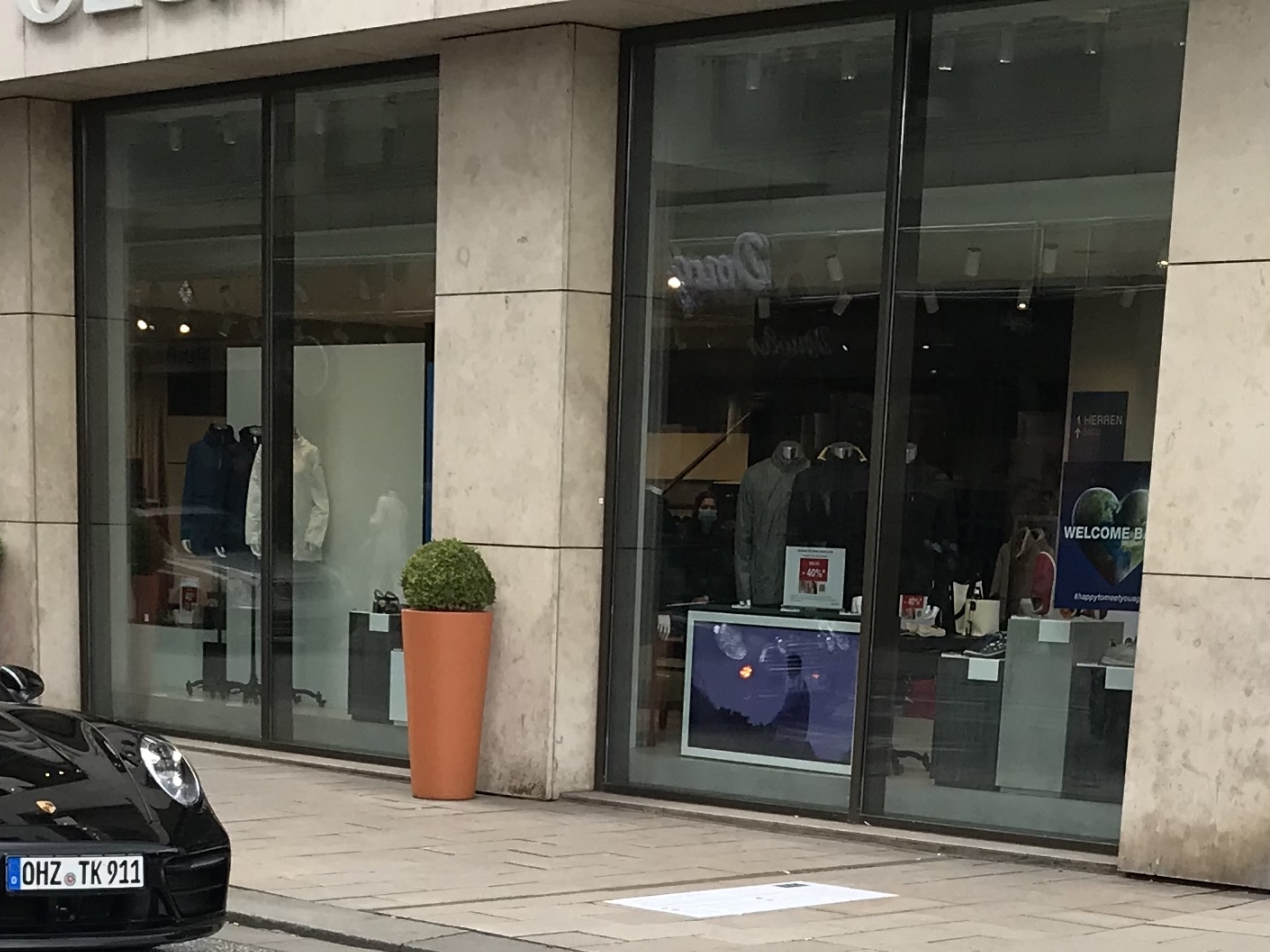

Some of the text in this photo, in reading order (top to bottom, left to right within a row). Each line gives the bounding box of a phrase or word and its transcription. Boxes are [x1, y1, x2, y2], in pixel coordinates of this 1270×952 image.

[1083, 414, 1123, 426] HERREN
[1063, 526, 1130, 540] WELCOME
[22, 860, 141, 886] OHZ TK 911
